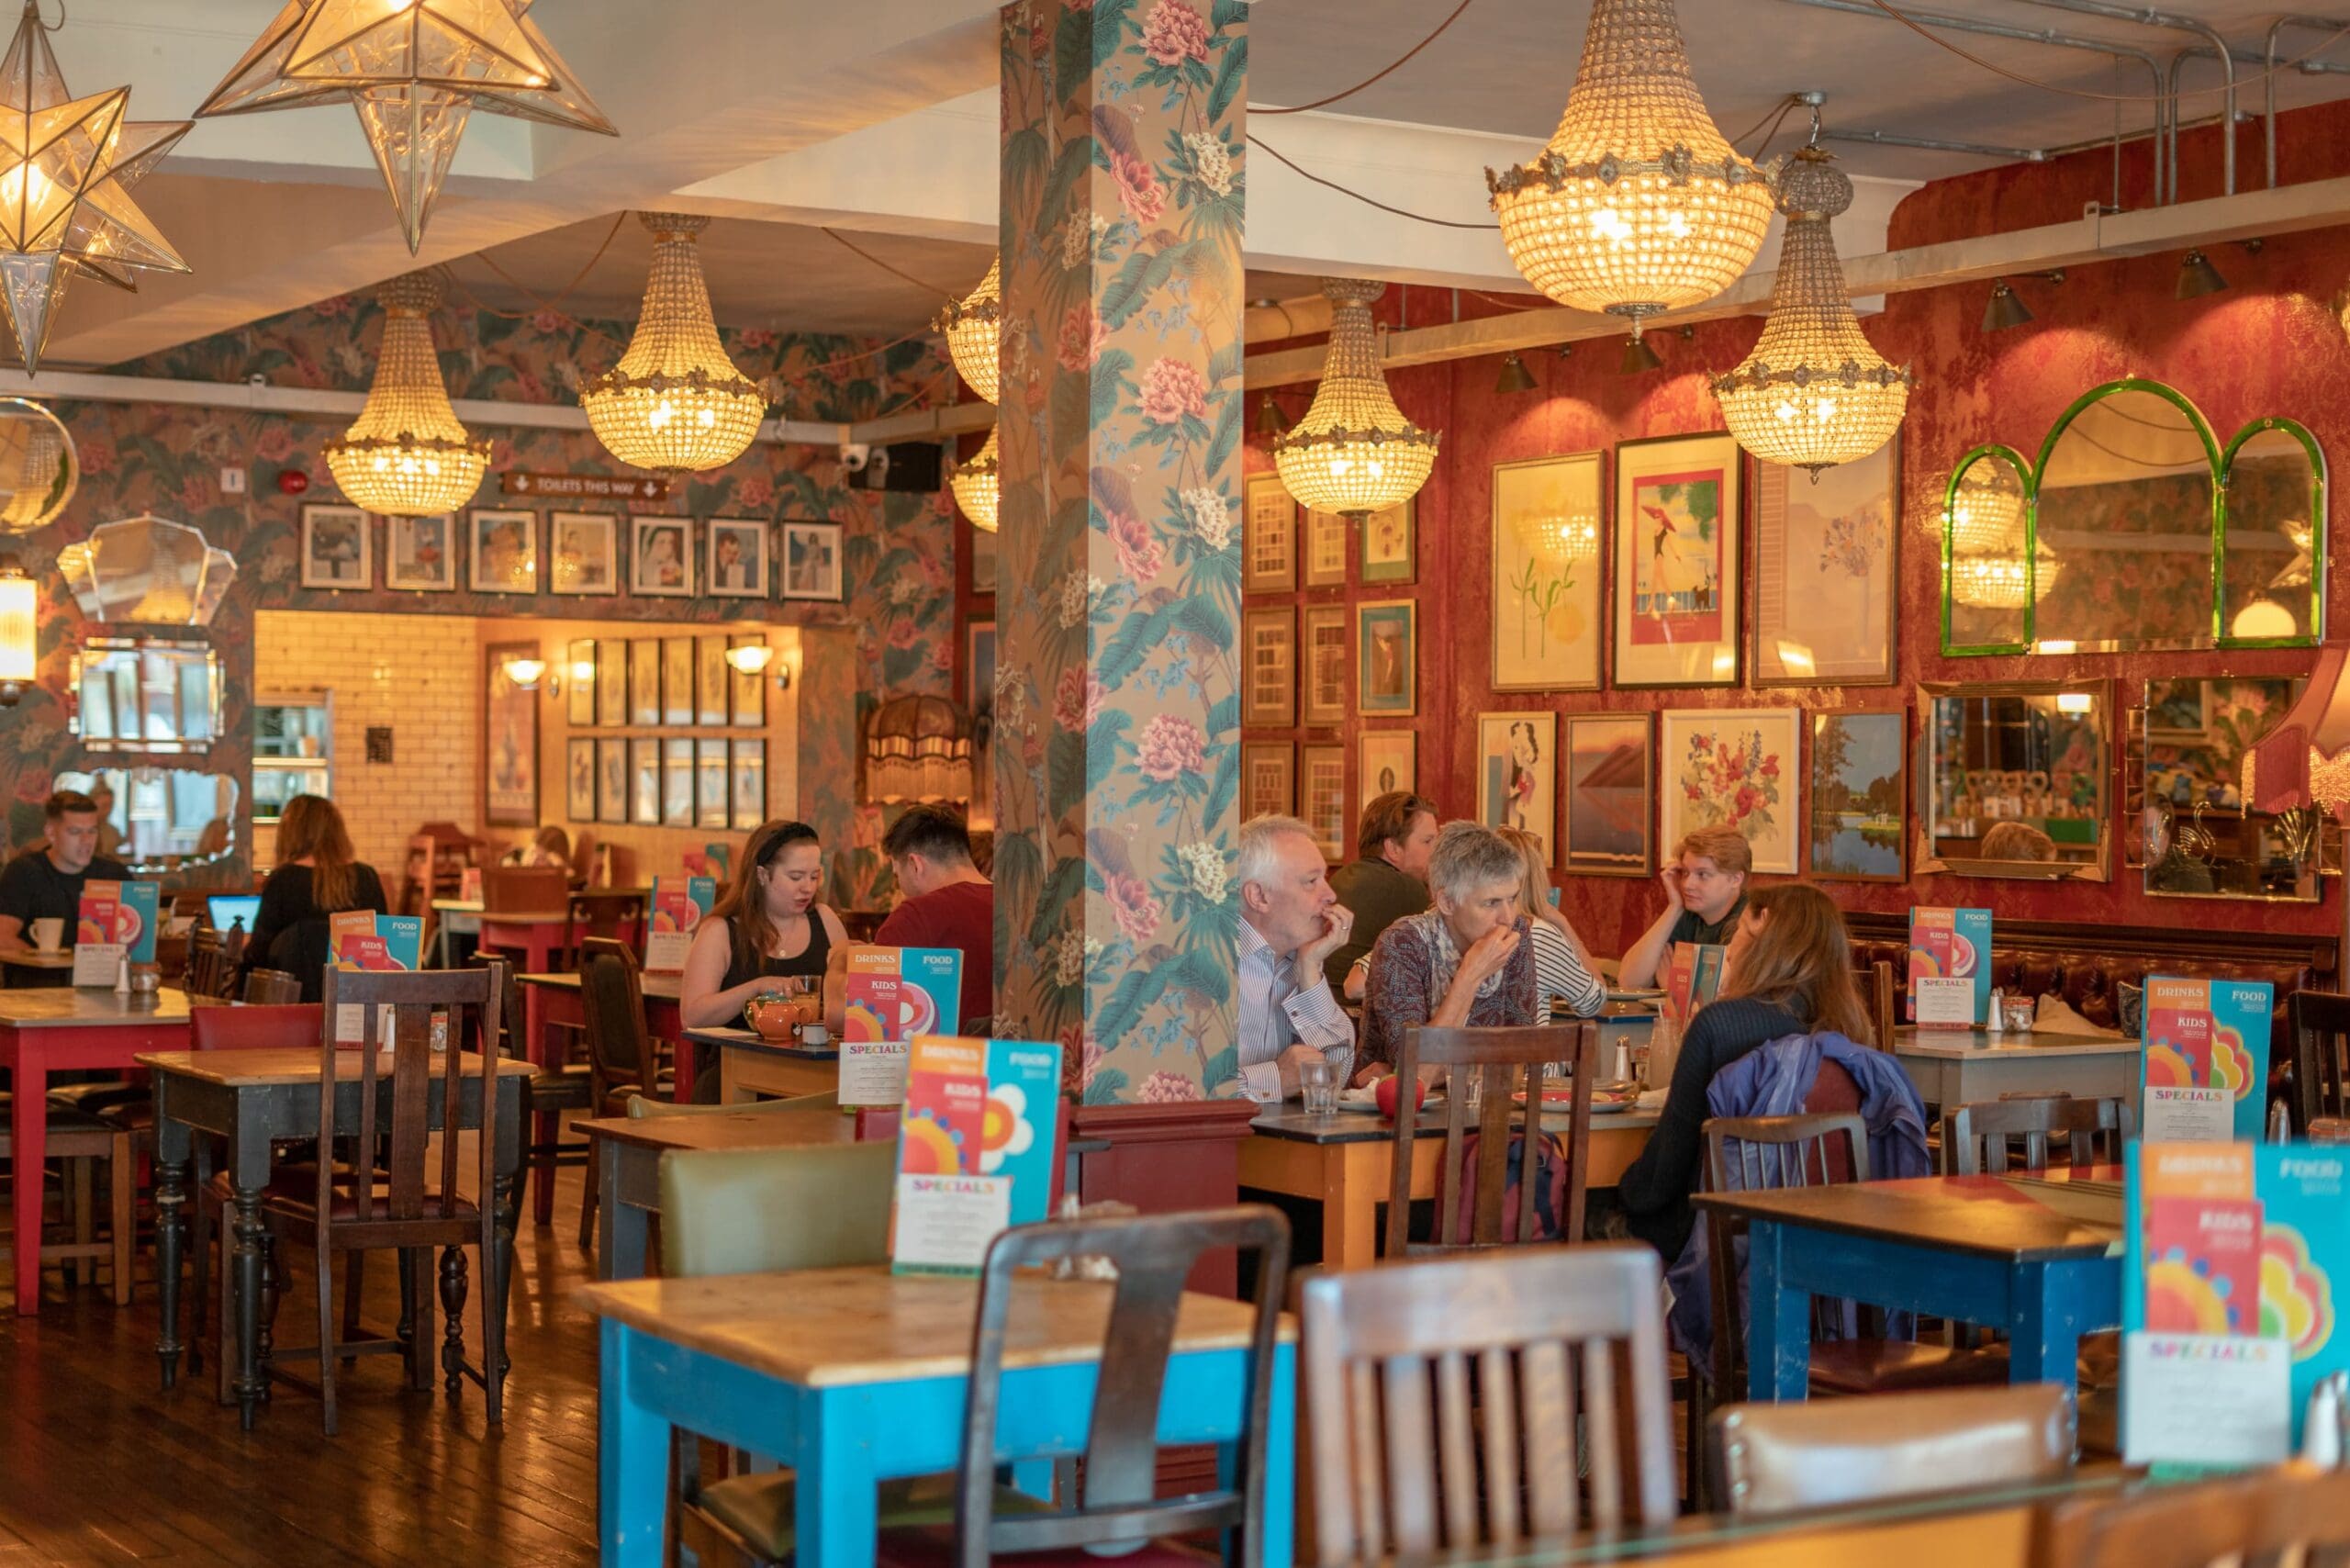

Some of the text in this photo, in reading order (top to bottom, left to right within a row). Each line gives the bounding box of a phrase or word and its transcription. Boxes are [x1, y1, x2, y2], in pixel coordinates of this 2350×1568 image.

[537, 477, 635, 495] TOILETS THIS WAY
[393, 922, 417, 930] FOOD
[361, 941, 382, 949] KIDS
[855, 954, 896, 963] DRINKS
[923, 956, 953, 964] FOOD
[871, 980, 897, 990] KIDS
[2157, 987, 2204, 997] DRINKS
[2232, 991, 2266, 1002] FOOD
[2177, 1017, 2207, 1027] KIDS
[849, 1045, 907, 1054] SPECIALS
[2155, 1090, 2223, 1102] SPECIALS
[912, 1179, 995, 1194] SPECIALS
[2149, 1340, 2269, 1362] SPECIALS
